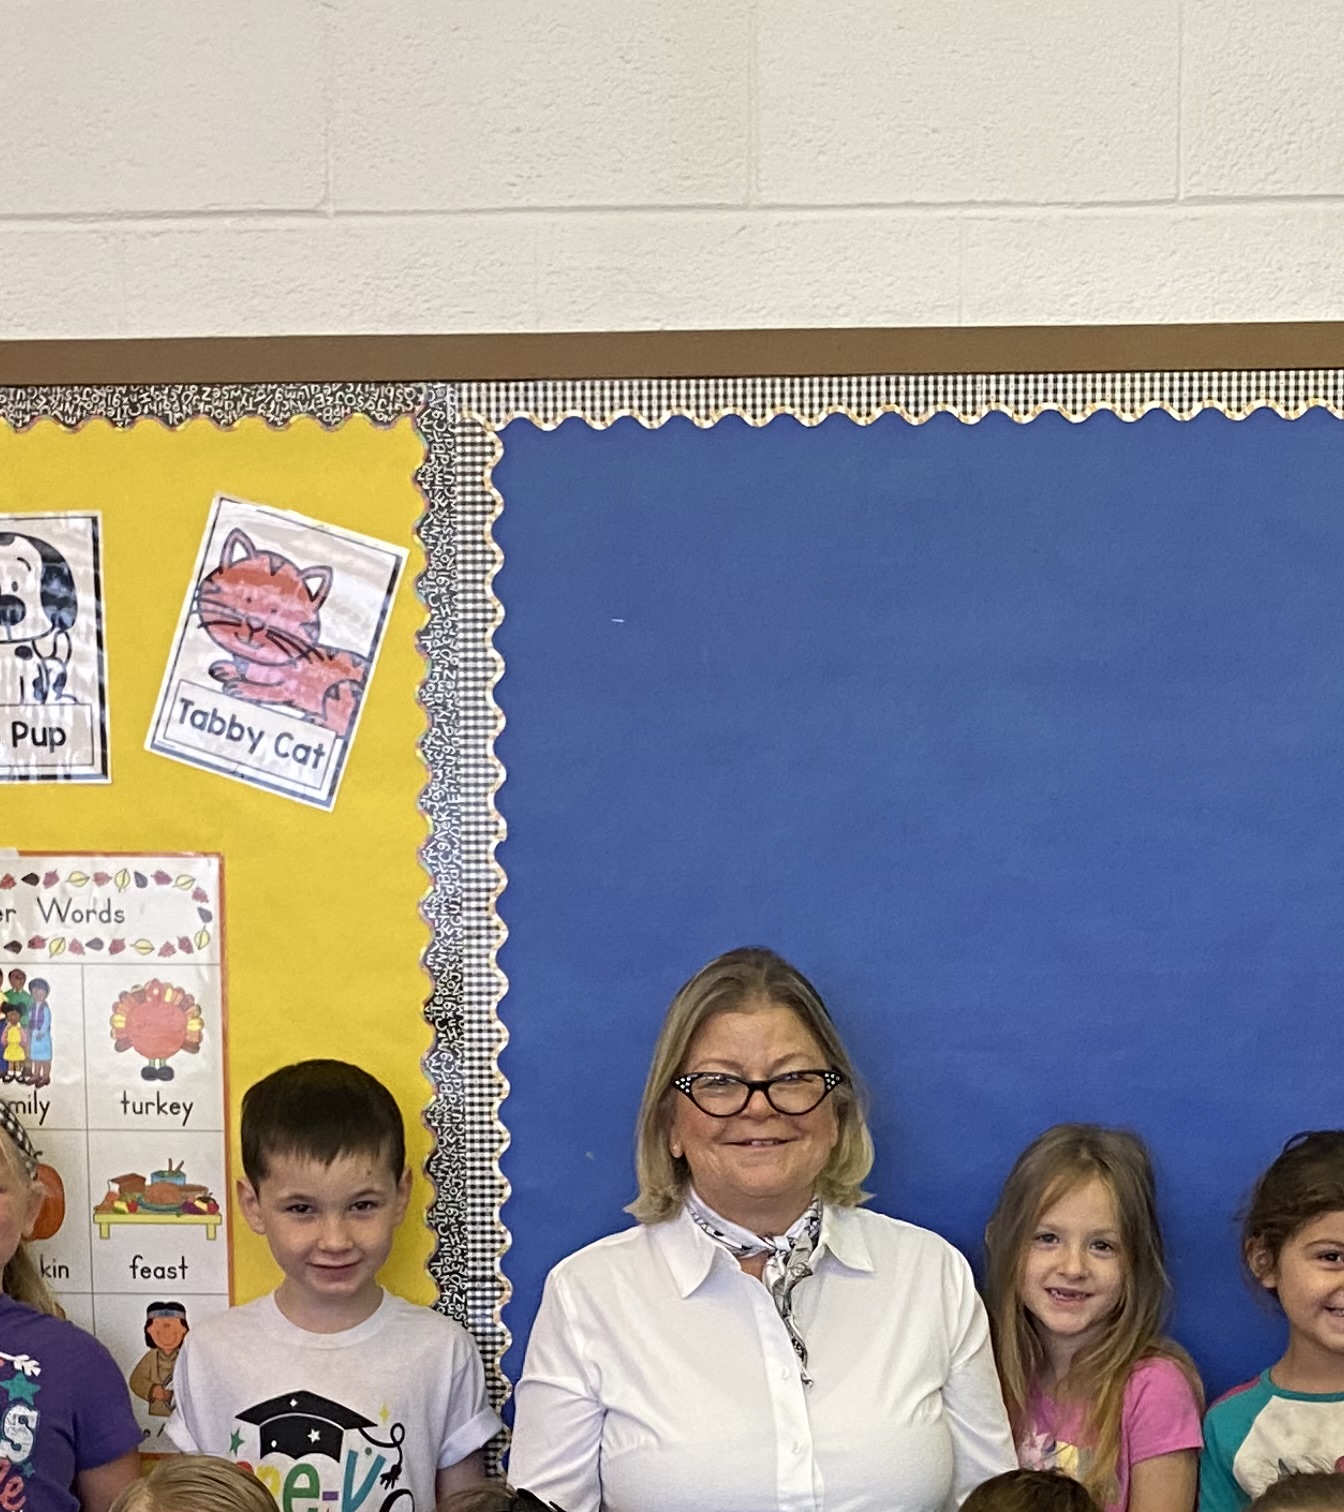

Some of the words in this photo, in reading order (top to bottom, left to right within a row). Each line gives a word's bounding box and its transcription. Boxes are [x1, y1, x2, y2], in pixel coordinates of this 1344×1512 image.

[12, 721, 66, 754] Pup
[180, 698, 264, 754] Tabby
[274, 732, 326, 769] Cat
[37, 897, 125, 924] Words
[8, 1090, 50, 1126] mily
[121, 1091, 194, 1126] turkey
[129, 1254, 188, 1280] feast
